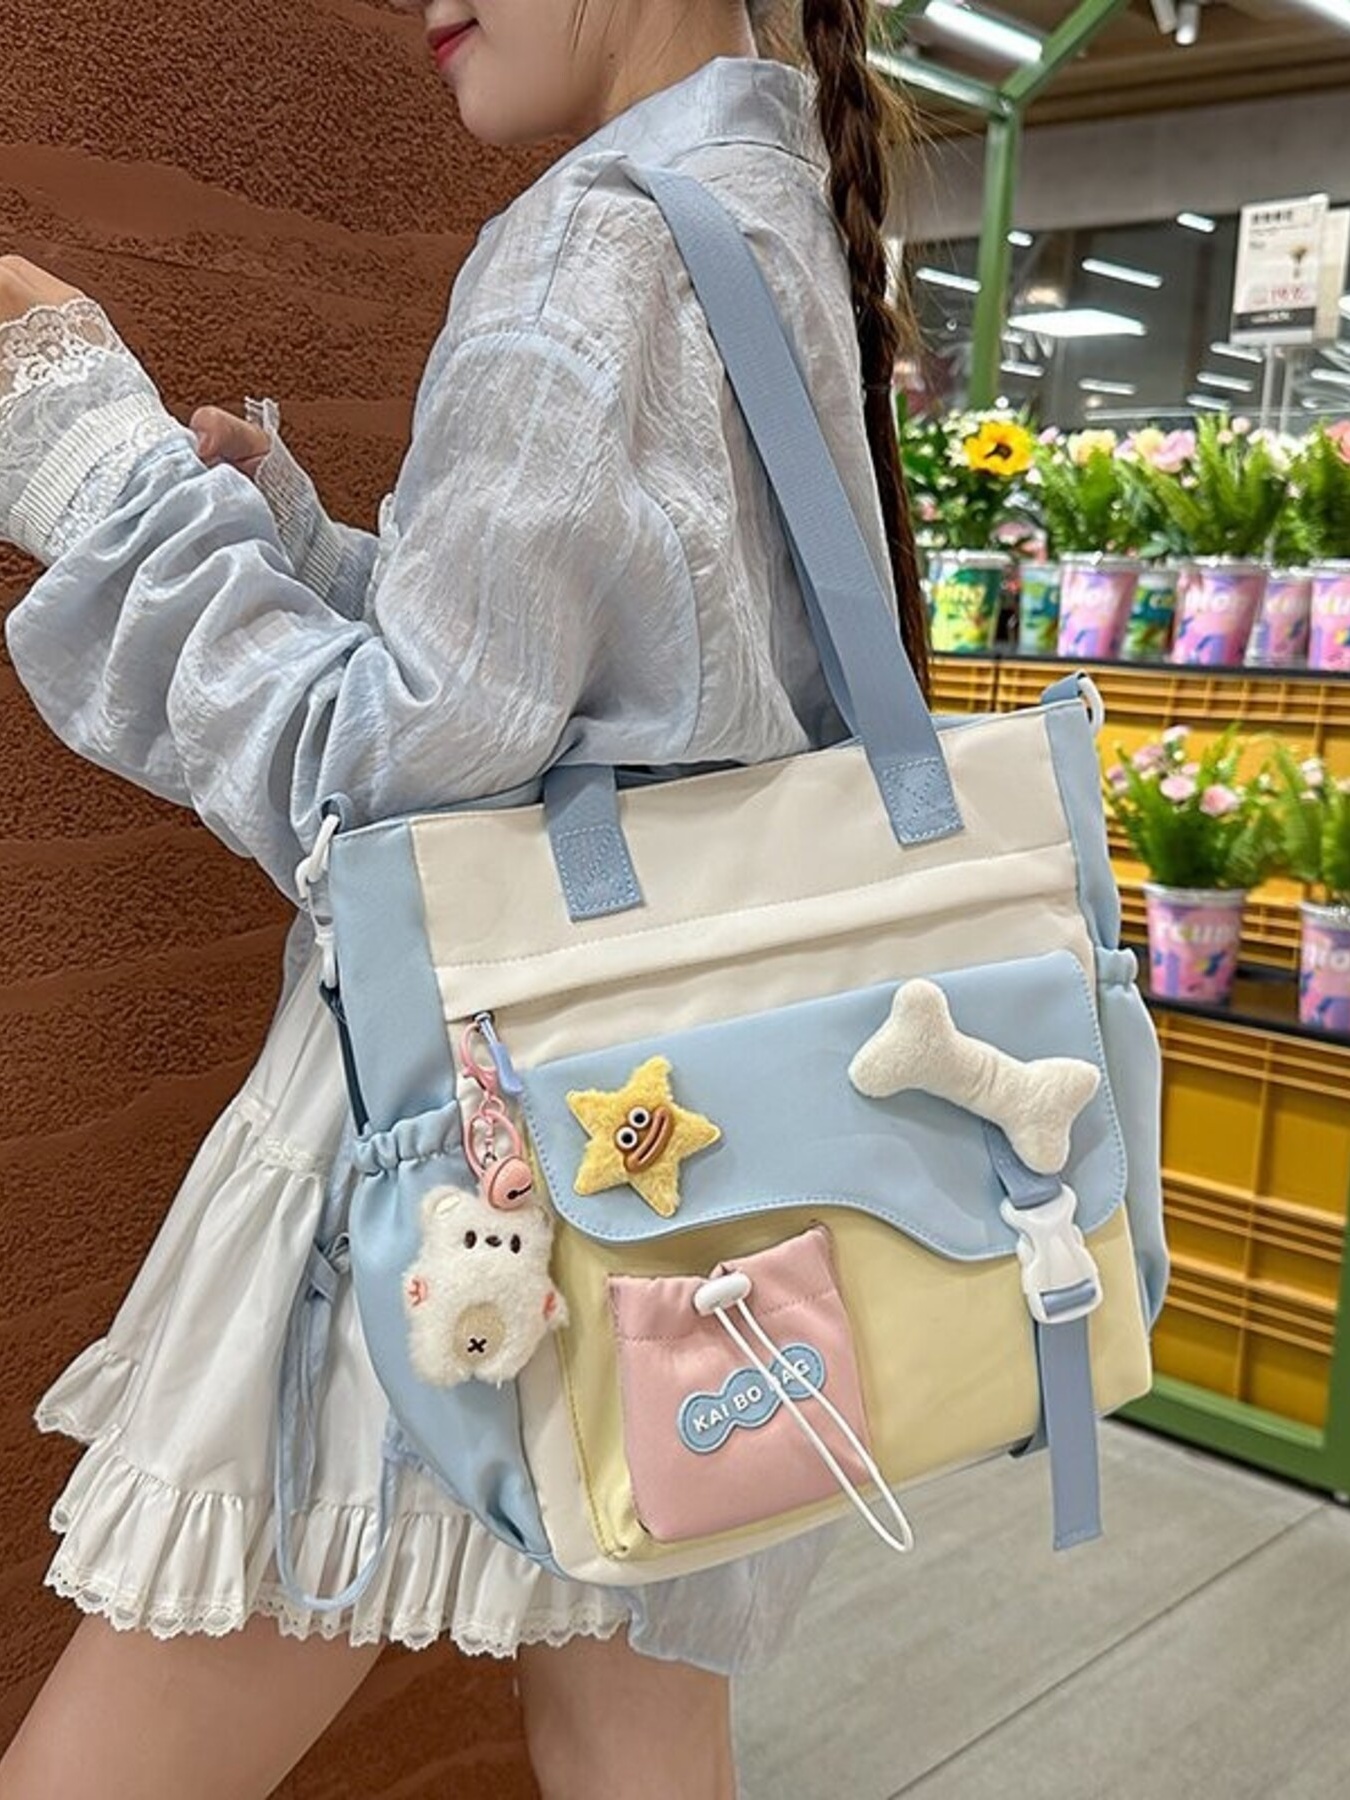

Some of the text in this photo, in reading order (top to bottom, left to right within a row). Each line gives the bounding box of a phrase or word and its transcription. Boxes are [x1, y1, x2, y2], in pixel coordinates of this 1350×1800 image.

[693, 1358, 811, 1433] KAI BO AG
